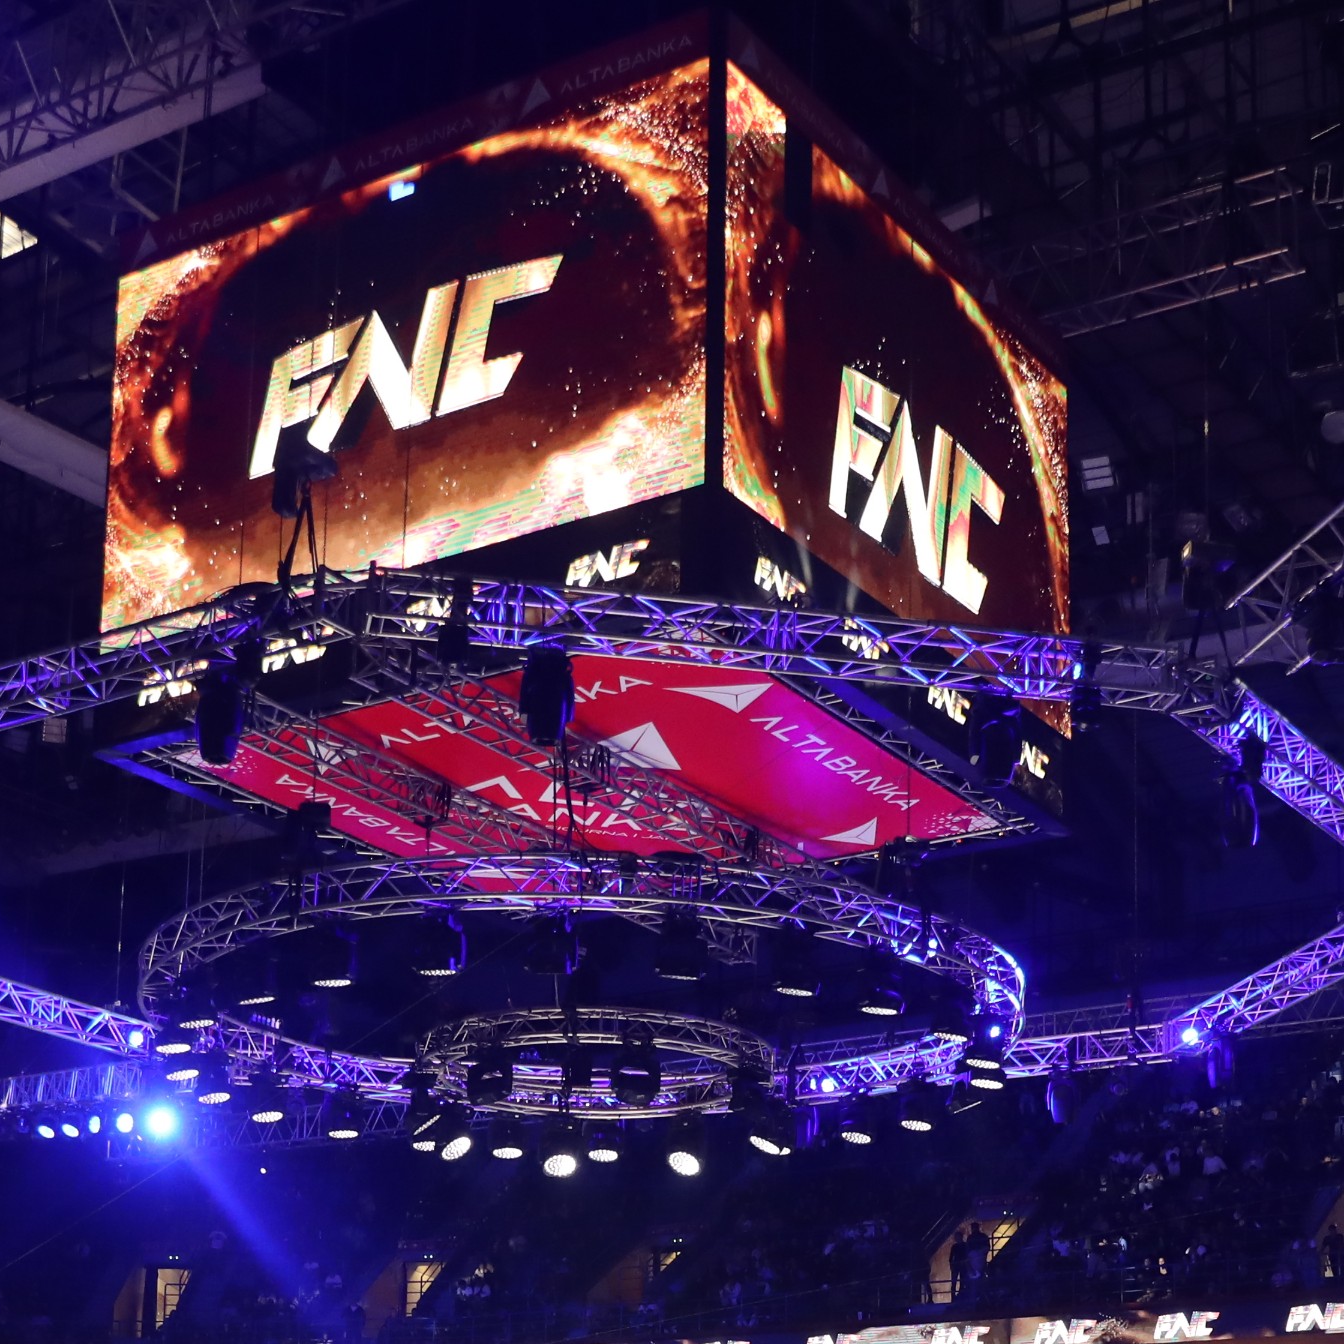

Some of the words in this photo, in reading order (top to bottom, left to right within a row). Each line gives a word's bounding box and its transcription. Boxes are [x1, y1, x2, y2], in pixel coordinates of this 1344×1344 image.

[560, 33, 694, 95] ALTABANKA
[355, 116, 474, 171] ALTABANKA
[165, 194, 275, 245] ALTABANKA
[249, 253, 564, 480] FNC
[828, 365, 1005, 615] FNC
[566, 539, 651, 588] FNC
[750, 715, 922, 812] ALTABANKA
[1019, 739, 1051, 779] NC
[1154, 1310, 1221, 1340] FNC
